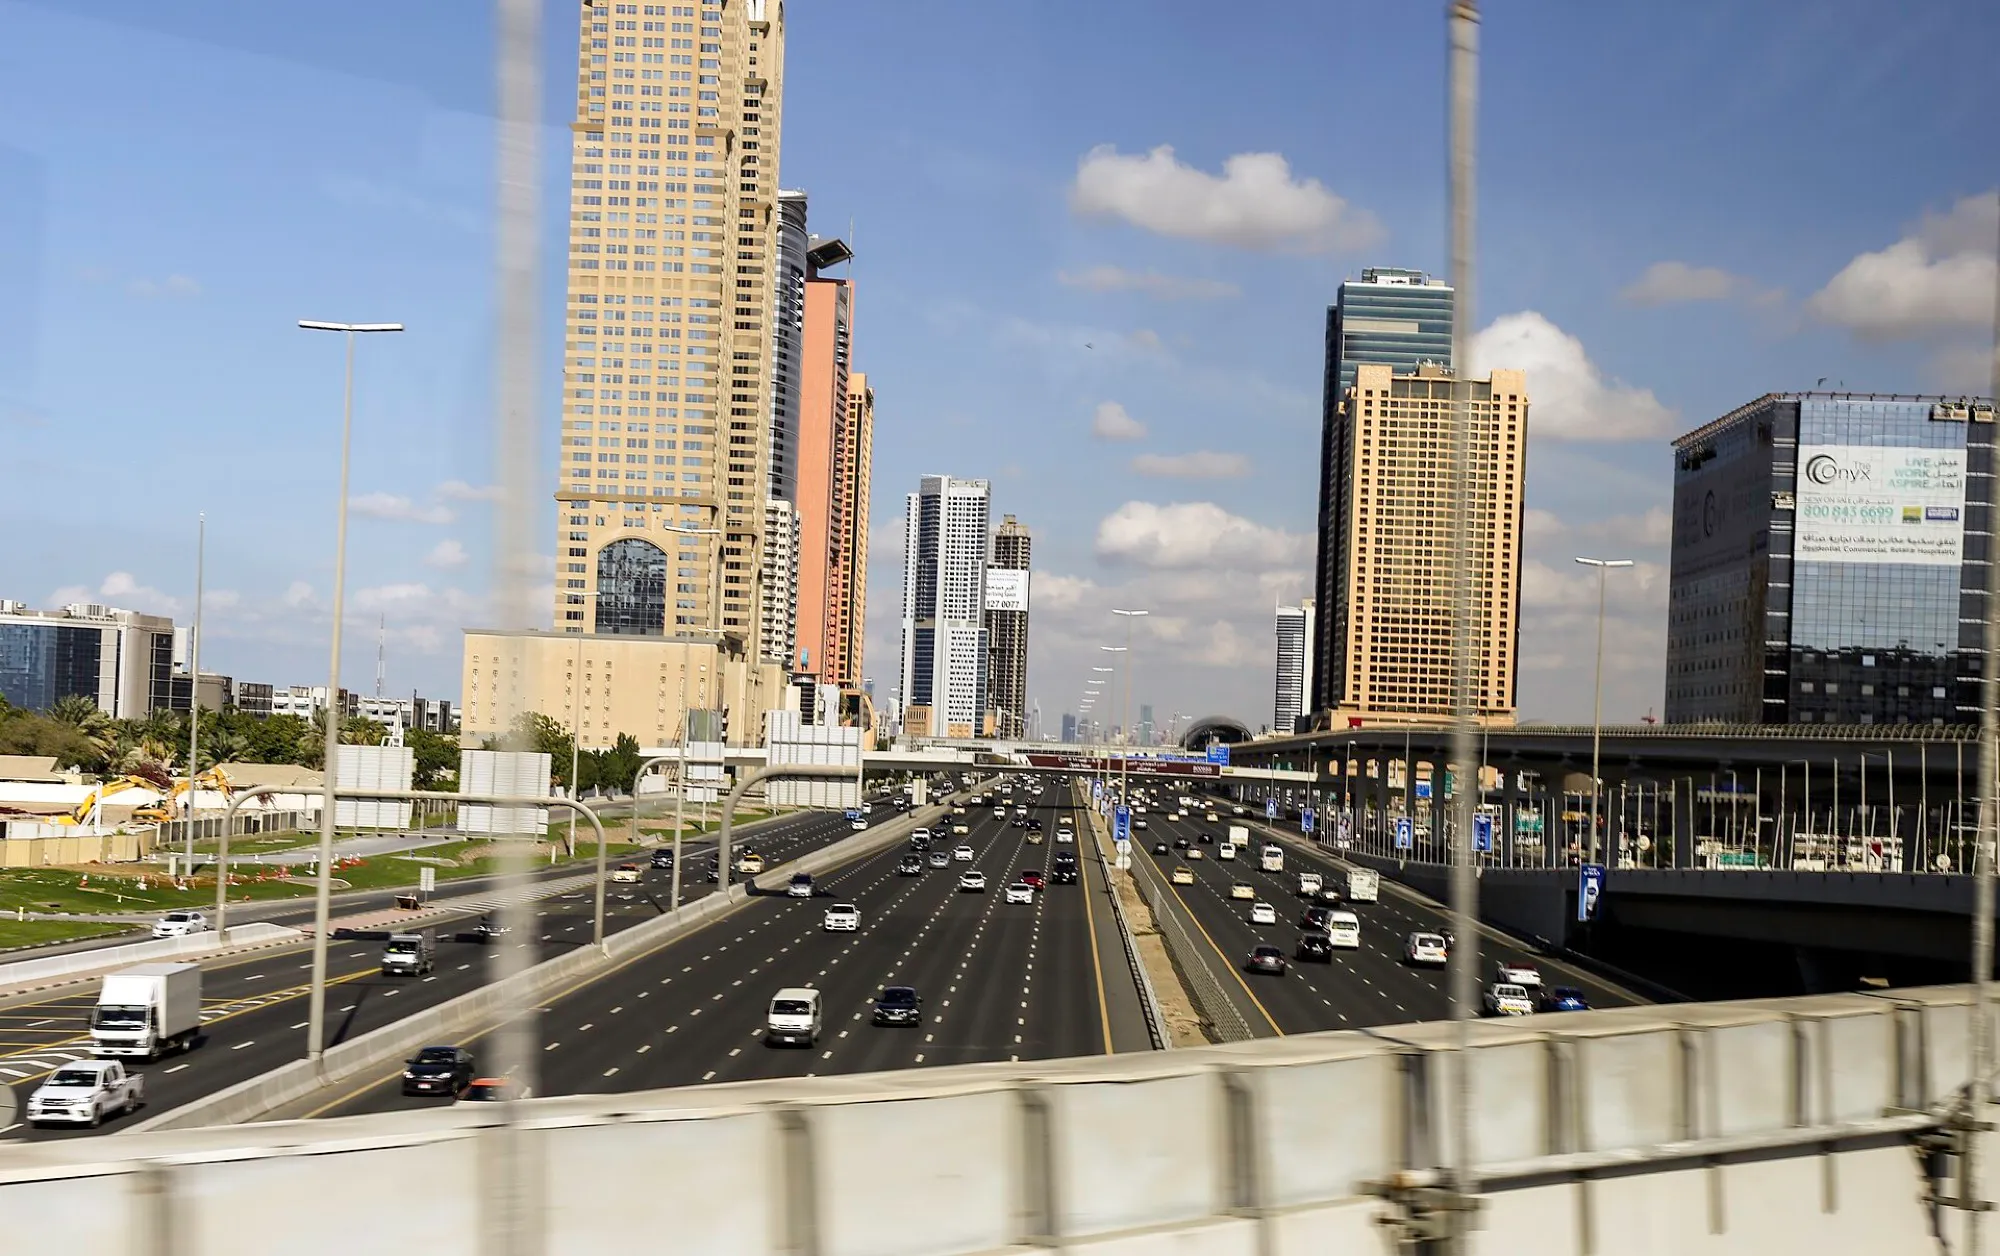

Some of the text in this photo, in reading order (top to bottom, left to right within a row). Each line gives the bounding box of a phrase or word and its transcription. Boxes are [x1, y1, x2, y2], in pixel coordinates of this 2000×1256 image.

[1853, 460, 1871, 470] The
[1905, 458, 1931, 467] LIVE
[1815, 459, 1871, 483] Onyx
[1894, 468, 1930, 478] WORK
[1888, 478, 1929, 489] ASPIRE
[1804, 496, 1851, 505] NOW ON SALE
[1803, 505, 1829, 518] 800
[1832, 505, 1857, 518] 843
[1860, 506, 1894, 519] 6699
[1917, 547, 1956, 556] Hospitality
[1001, 600, 1020, 608] 0077
